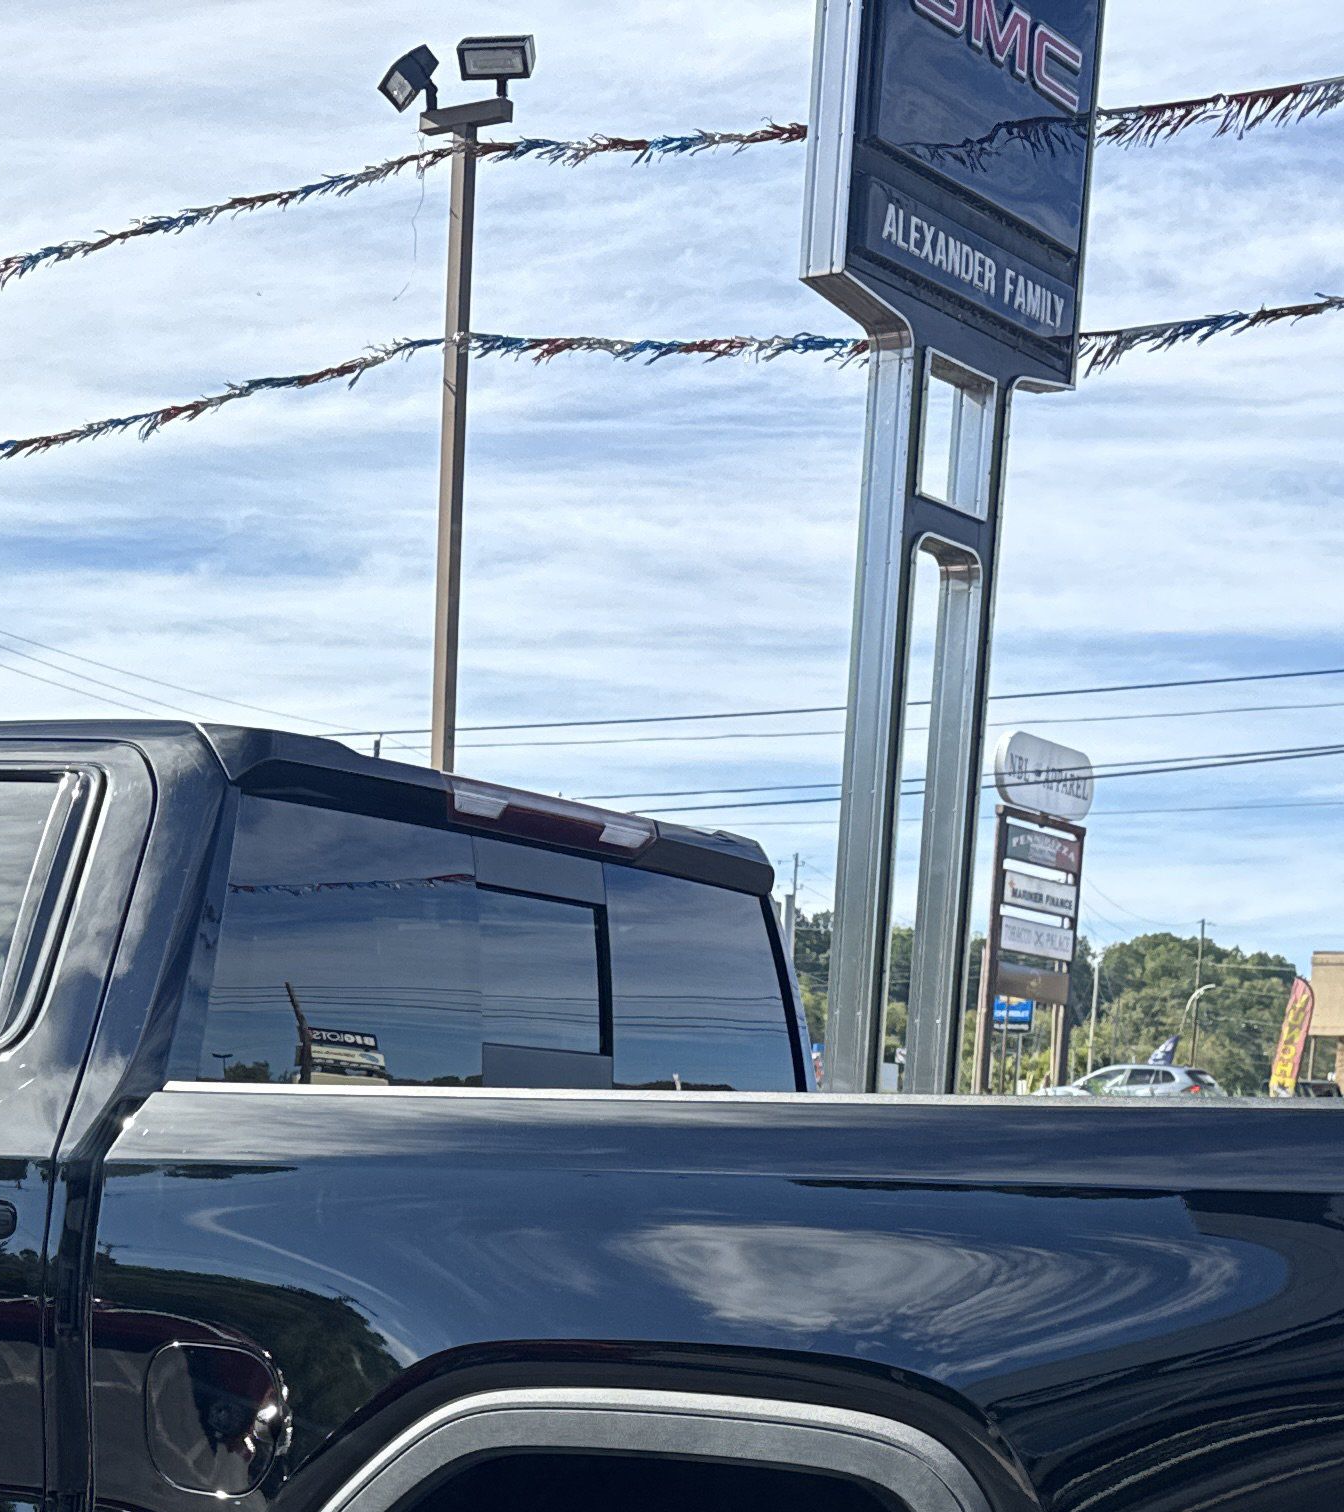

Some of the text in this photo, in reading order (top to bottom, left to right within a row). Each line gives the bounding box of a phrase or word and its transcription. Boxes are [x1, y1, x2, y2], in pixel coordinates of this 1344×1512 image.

[882, 203, 1064, 328] ALEXANDER FAMILY
[1011, 888, 1072, 911] MARINER FINANCE
